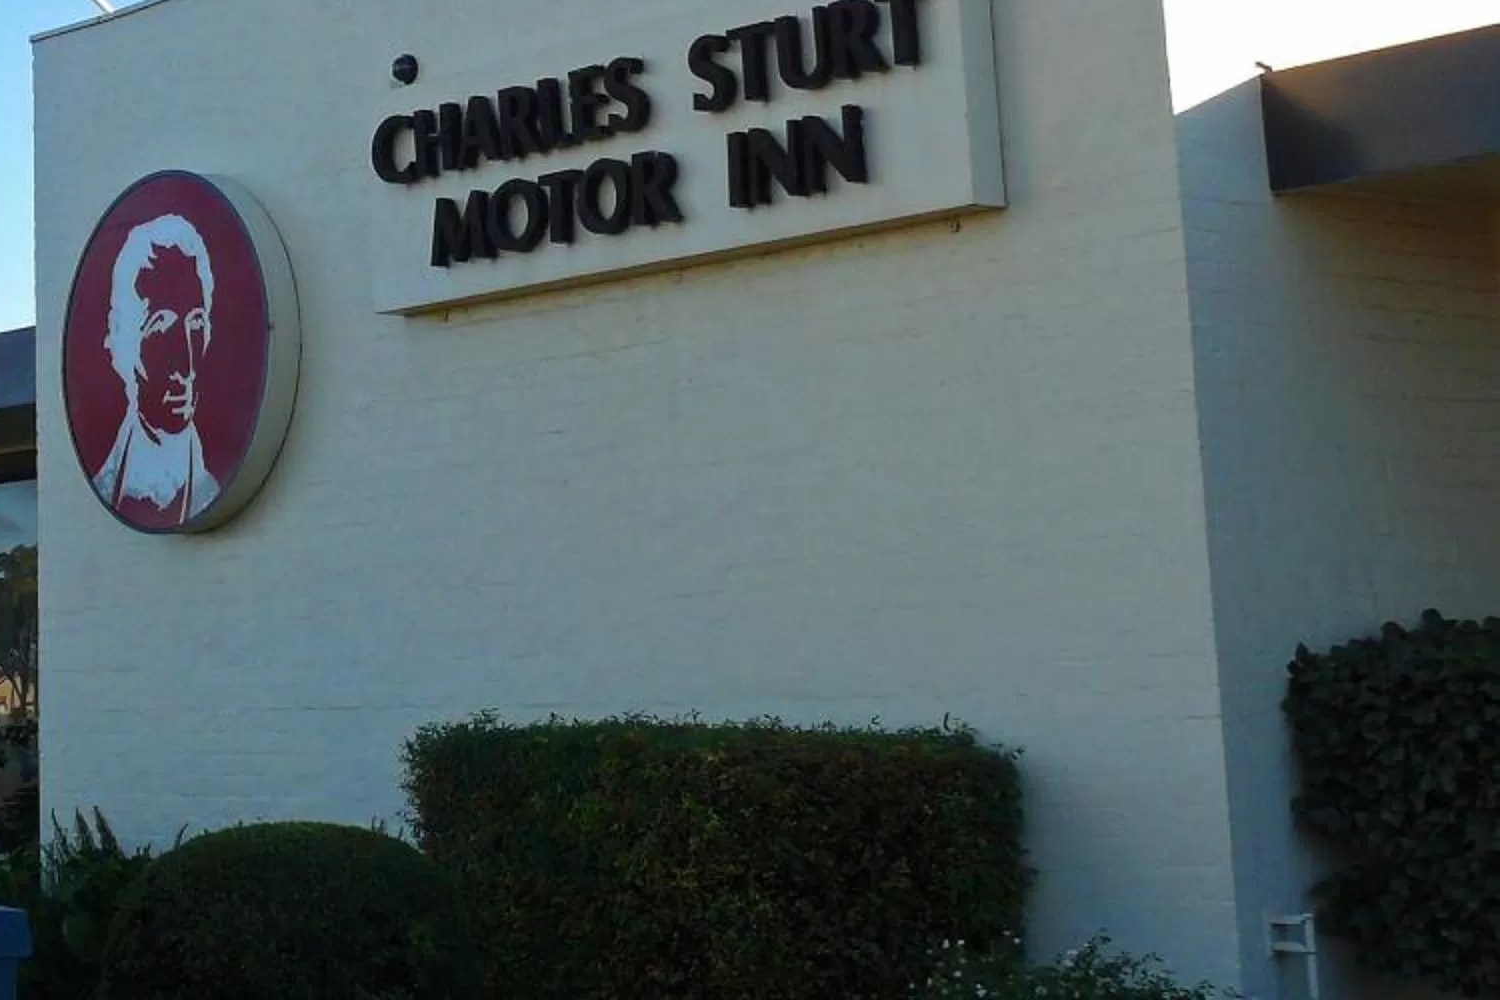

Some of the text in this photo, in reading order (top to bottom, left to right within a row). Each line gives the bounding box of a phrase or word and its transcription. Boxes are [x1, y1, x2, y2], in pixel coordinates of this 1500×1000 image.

[372, 56, 650, 185] CHARLES
[431, 104, 868, 268] MOTOR INN
